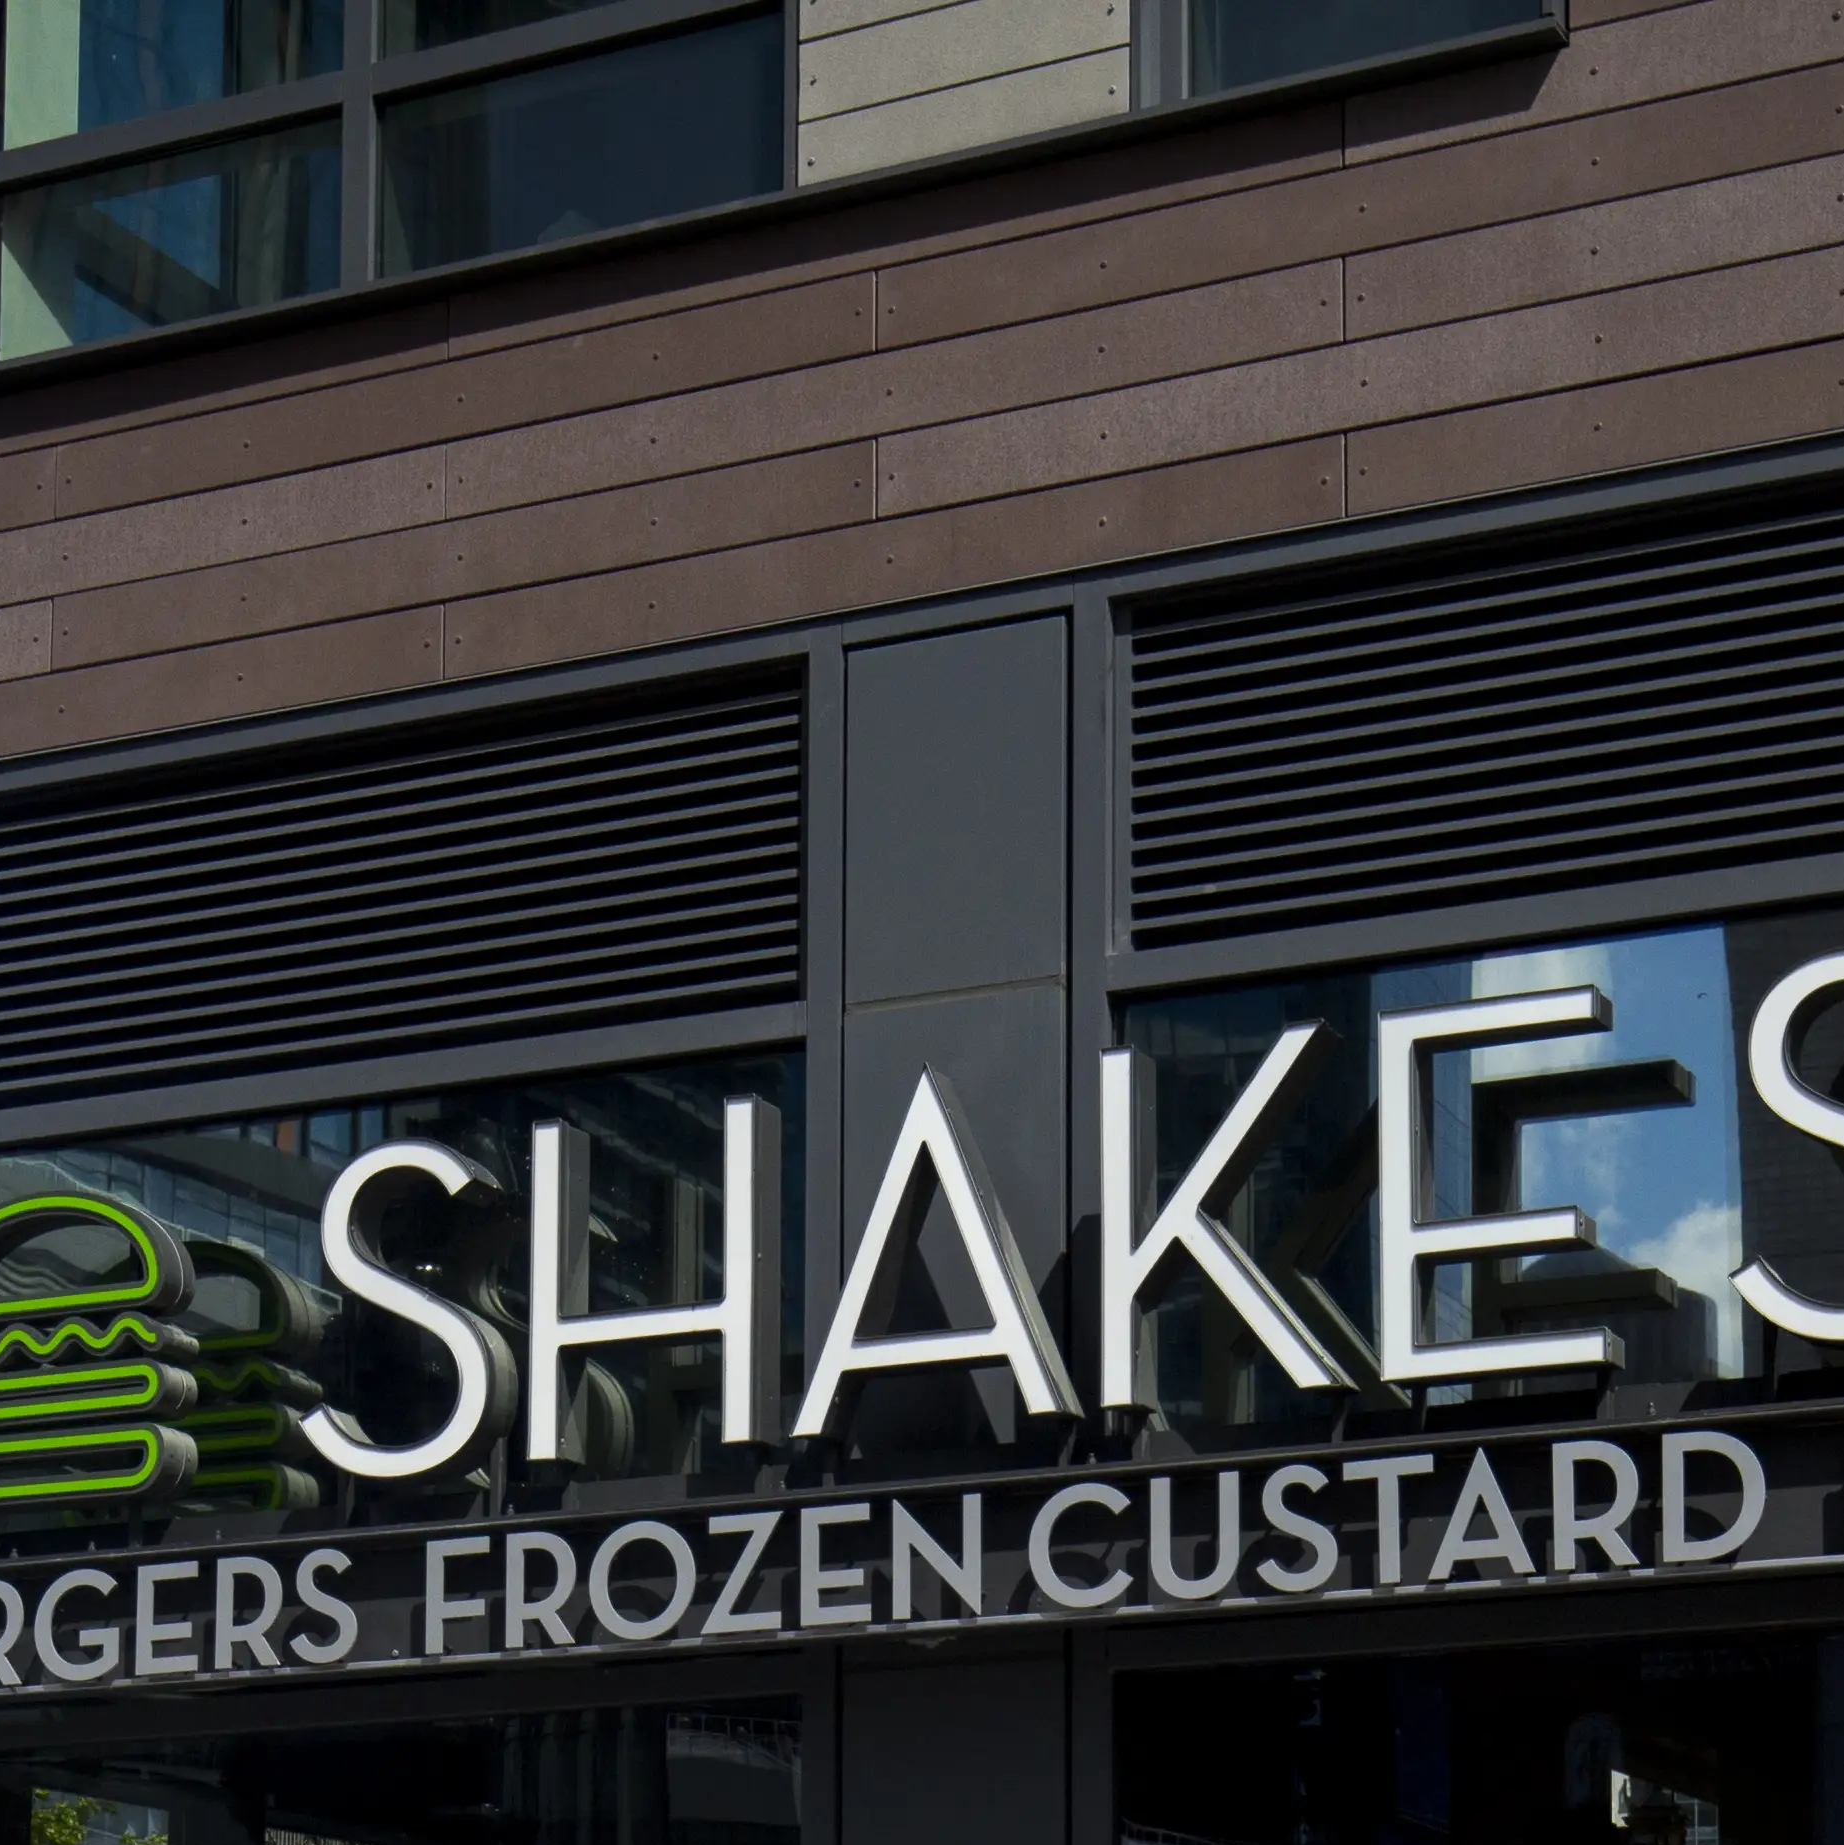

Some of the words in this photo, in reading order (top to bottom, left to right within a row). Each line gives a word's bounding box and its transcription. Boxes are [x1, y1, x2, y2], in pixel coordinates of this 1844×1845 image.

[298, 984, 1620, 1479] SHAKE
[425, 1492, 983, 1656] FROZEN
[1028, 1430, 1767, 1608] CUSTARD
